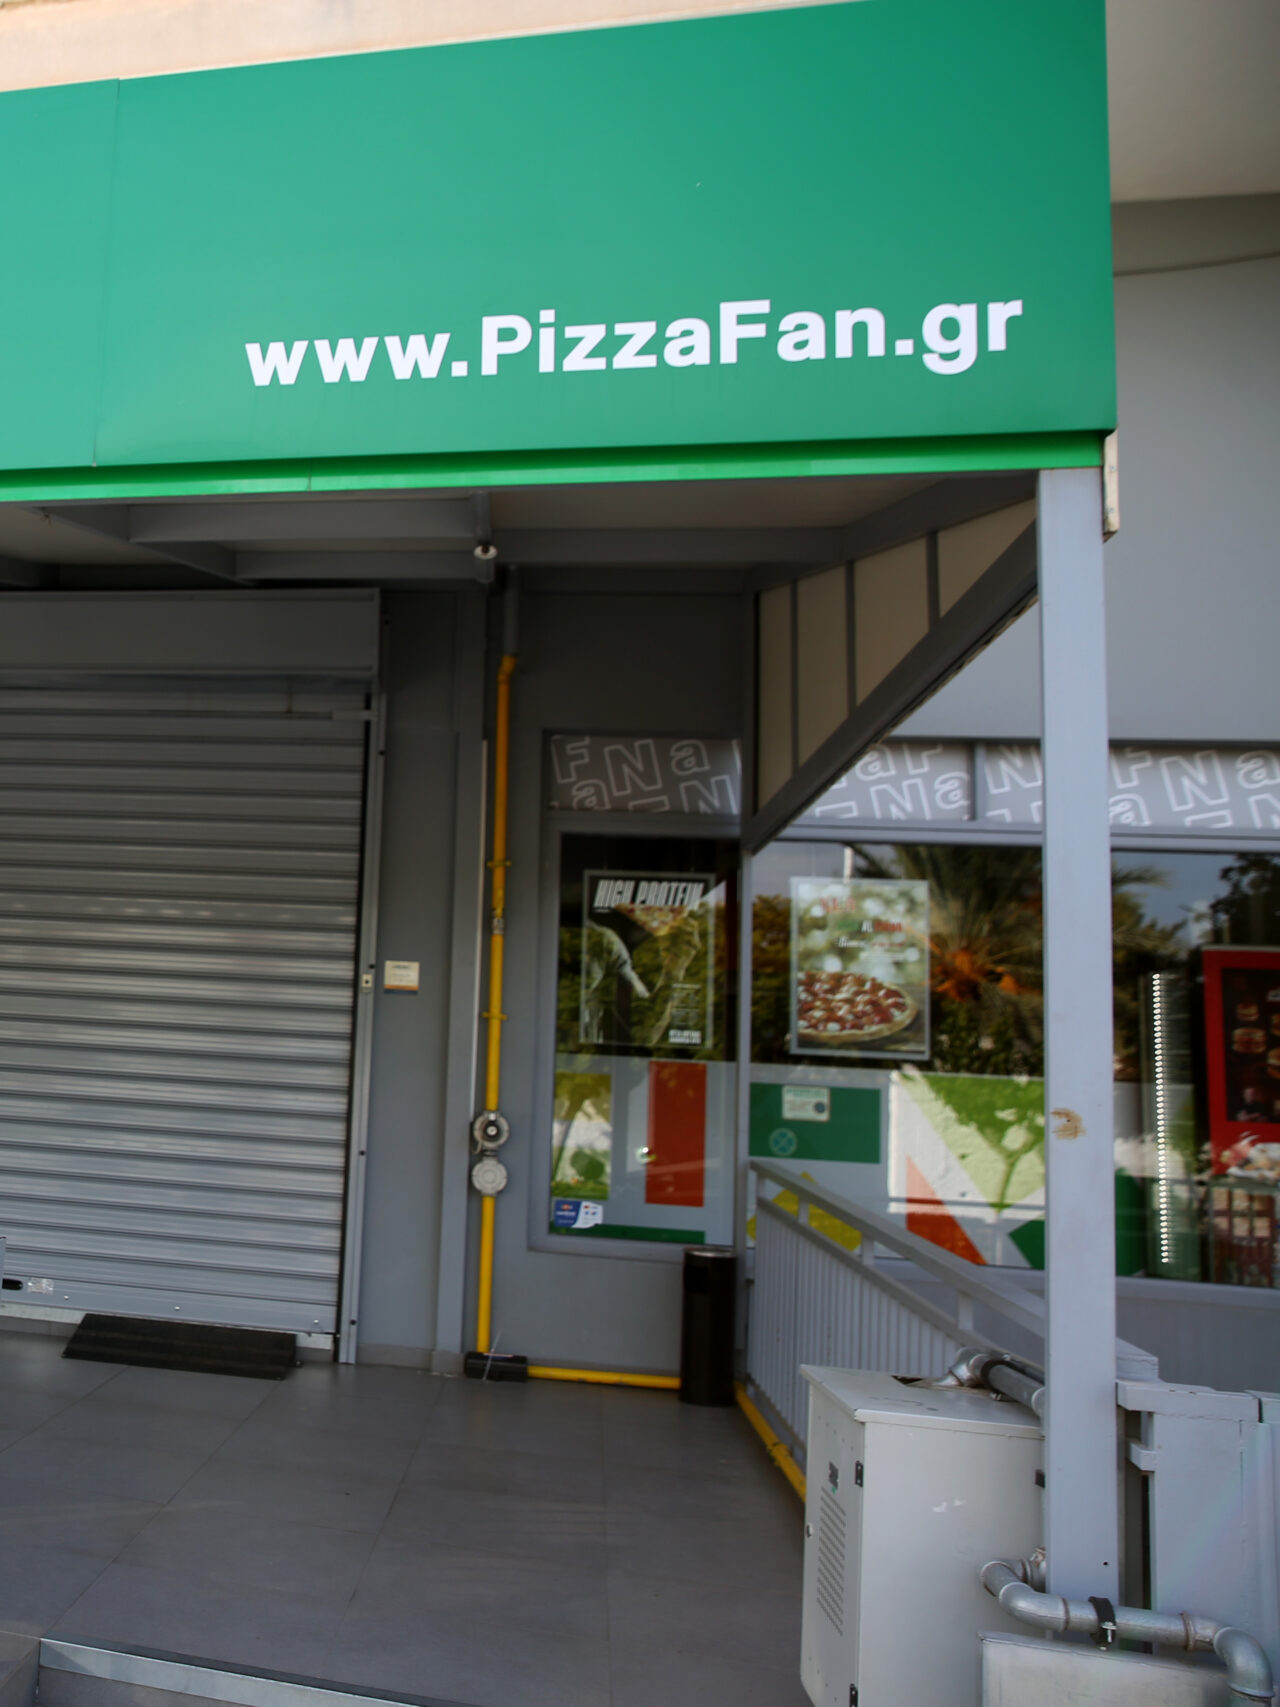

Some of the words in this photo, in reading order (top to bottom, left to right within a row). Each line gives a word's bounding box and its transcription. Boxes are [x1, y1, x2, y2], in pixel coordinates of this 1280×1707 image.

[244, 299, 1024, 387] www.PizzaFan.gr
[593, 879, 636, 908] HIGH
[634, 881, 705, 911] PROTEIN
